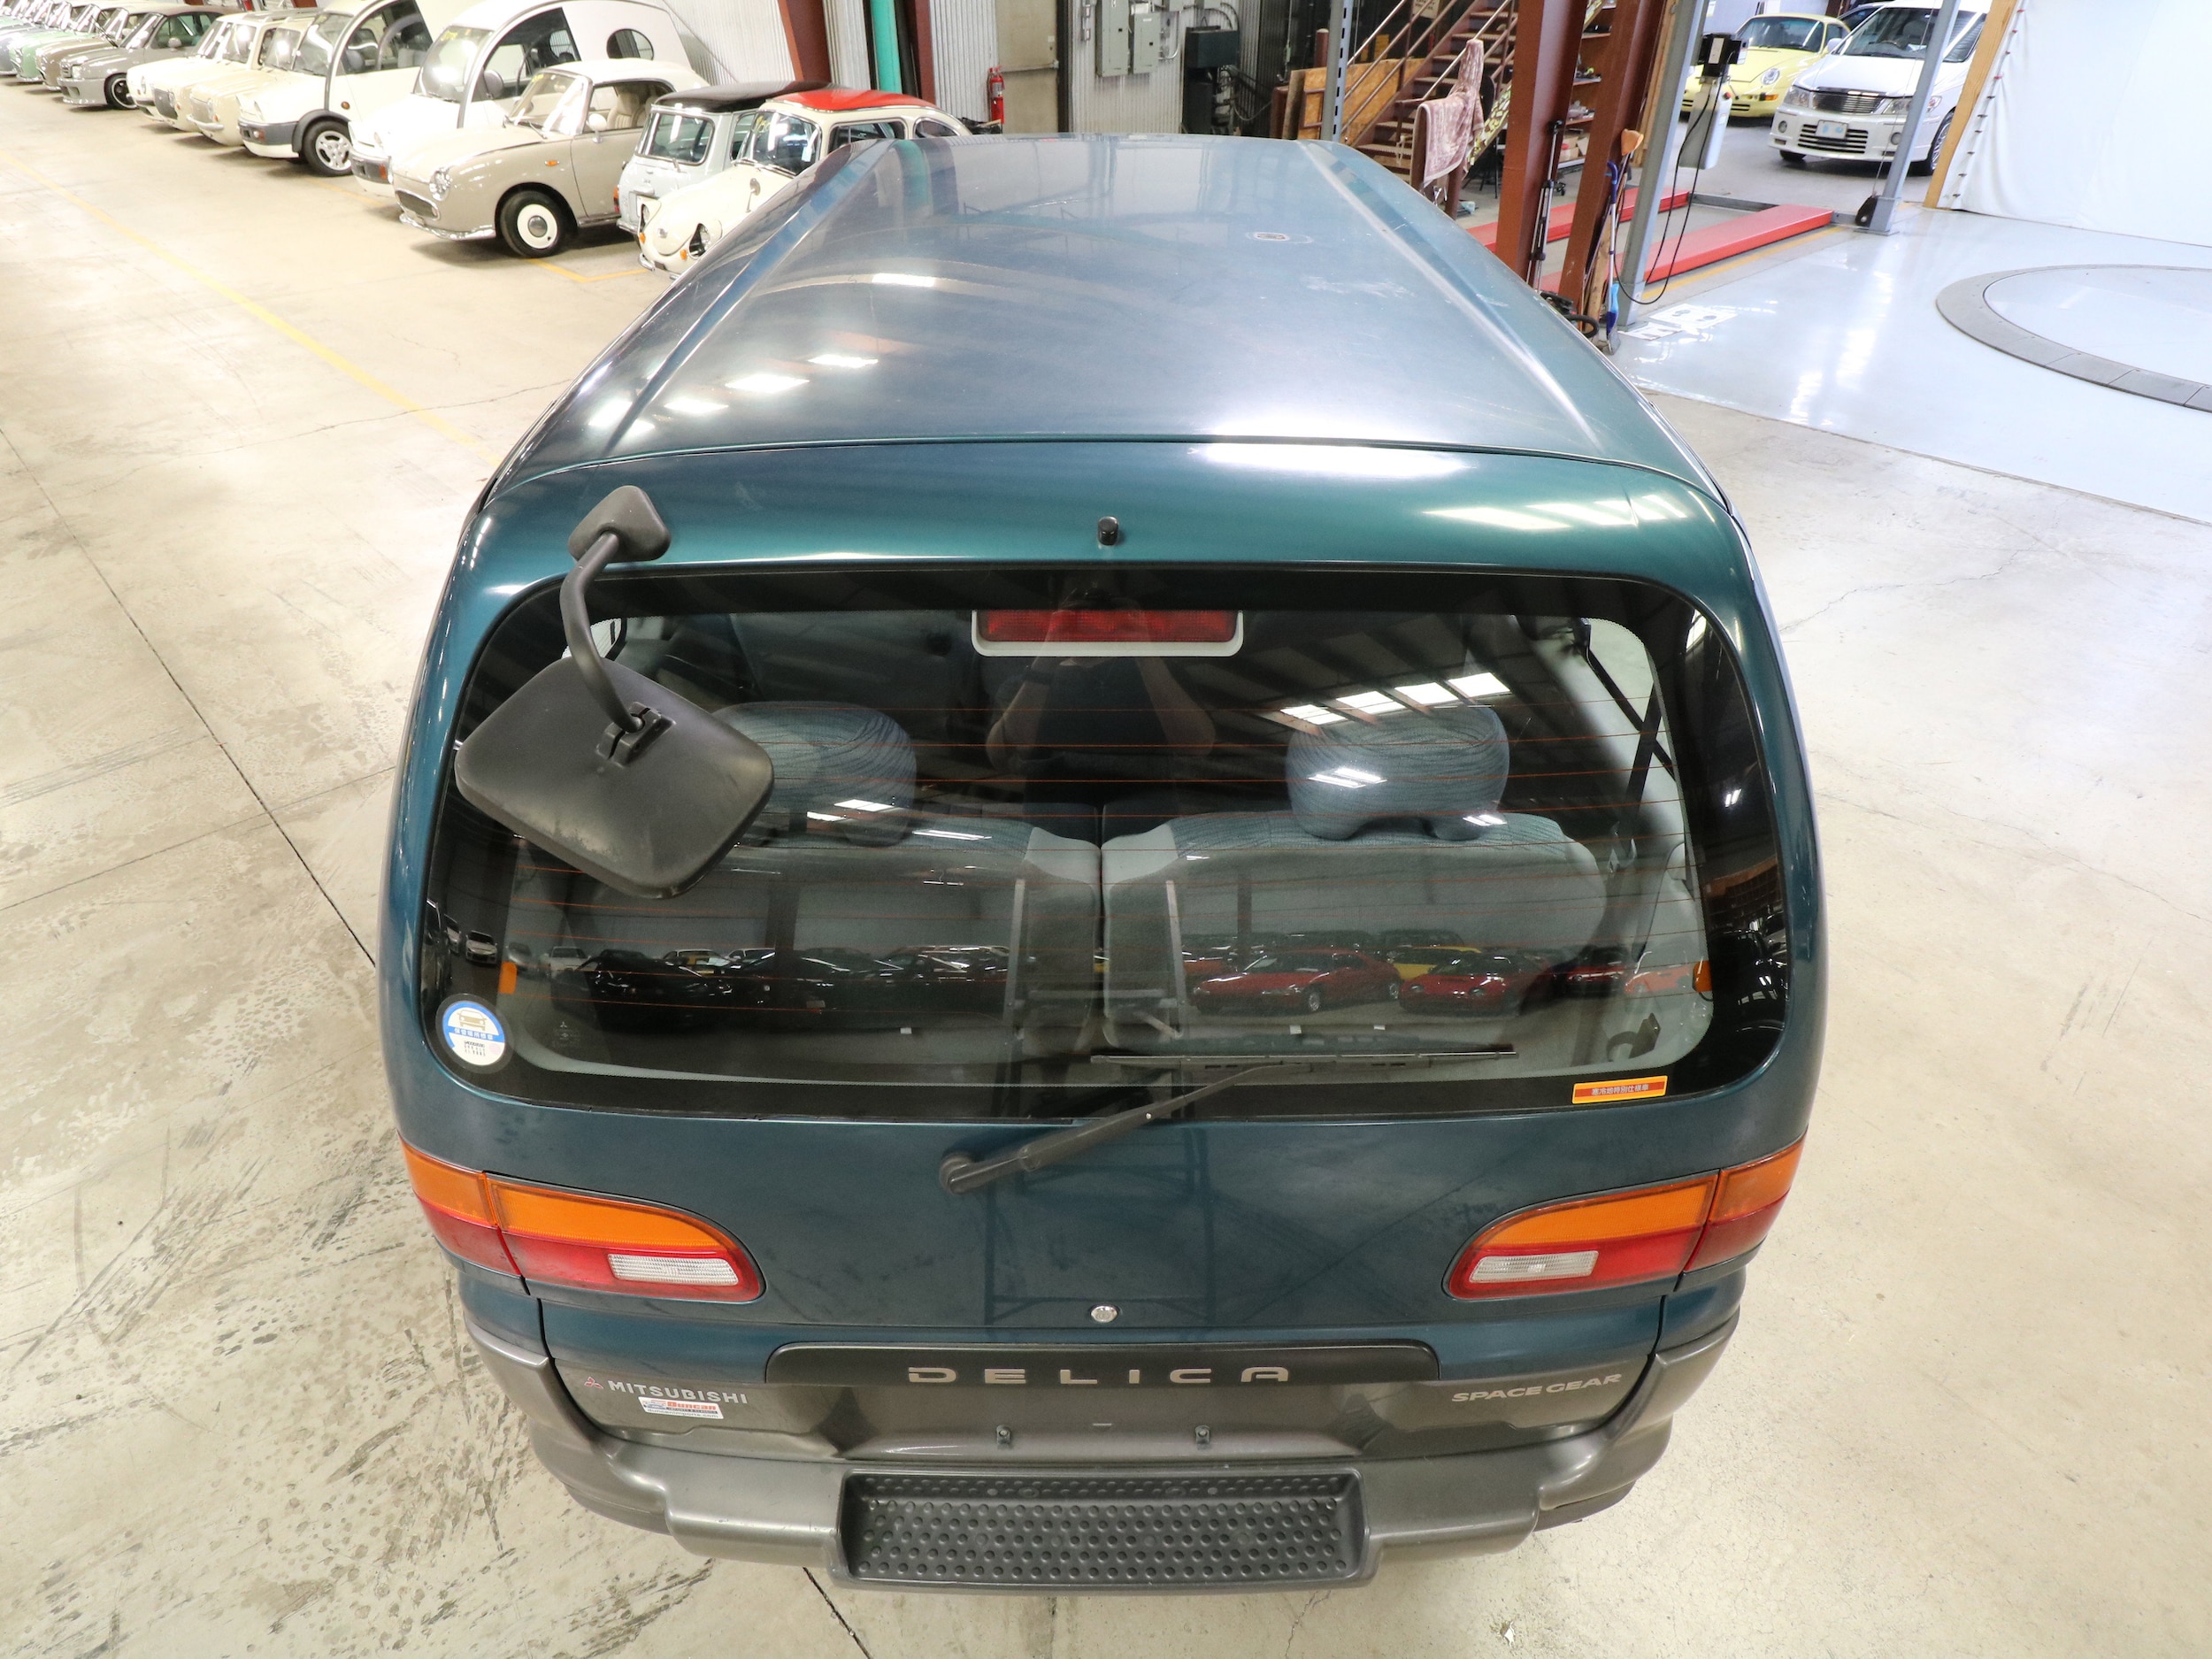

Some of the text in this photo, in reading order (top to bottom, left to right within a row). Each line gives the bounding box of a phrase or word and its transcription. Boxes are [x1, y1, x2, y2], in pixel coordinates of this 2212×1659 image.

[1592, 1084, 1648, 1095] 寒冷地特別仕様車
[908, 1366, 1288, 1385] DELICA
[607, 1380, 749, 1403] MITSUBISHI
[1451, 1373, 1622, 1402] SPACE GEAR
[647, 1409, 718, 1417] duncanimports.com
[667, 1402, 716, 1410] Duncan
